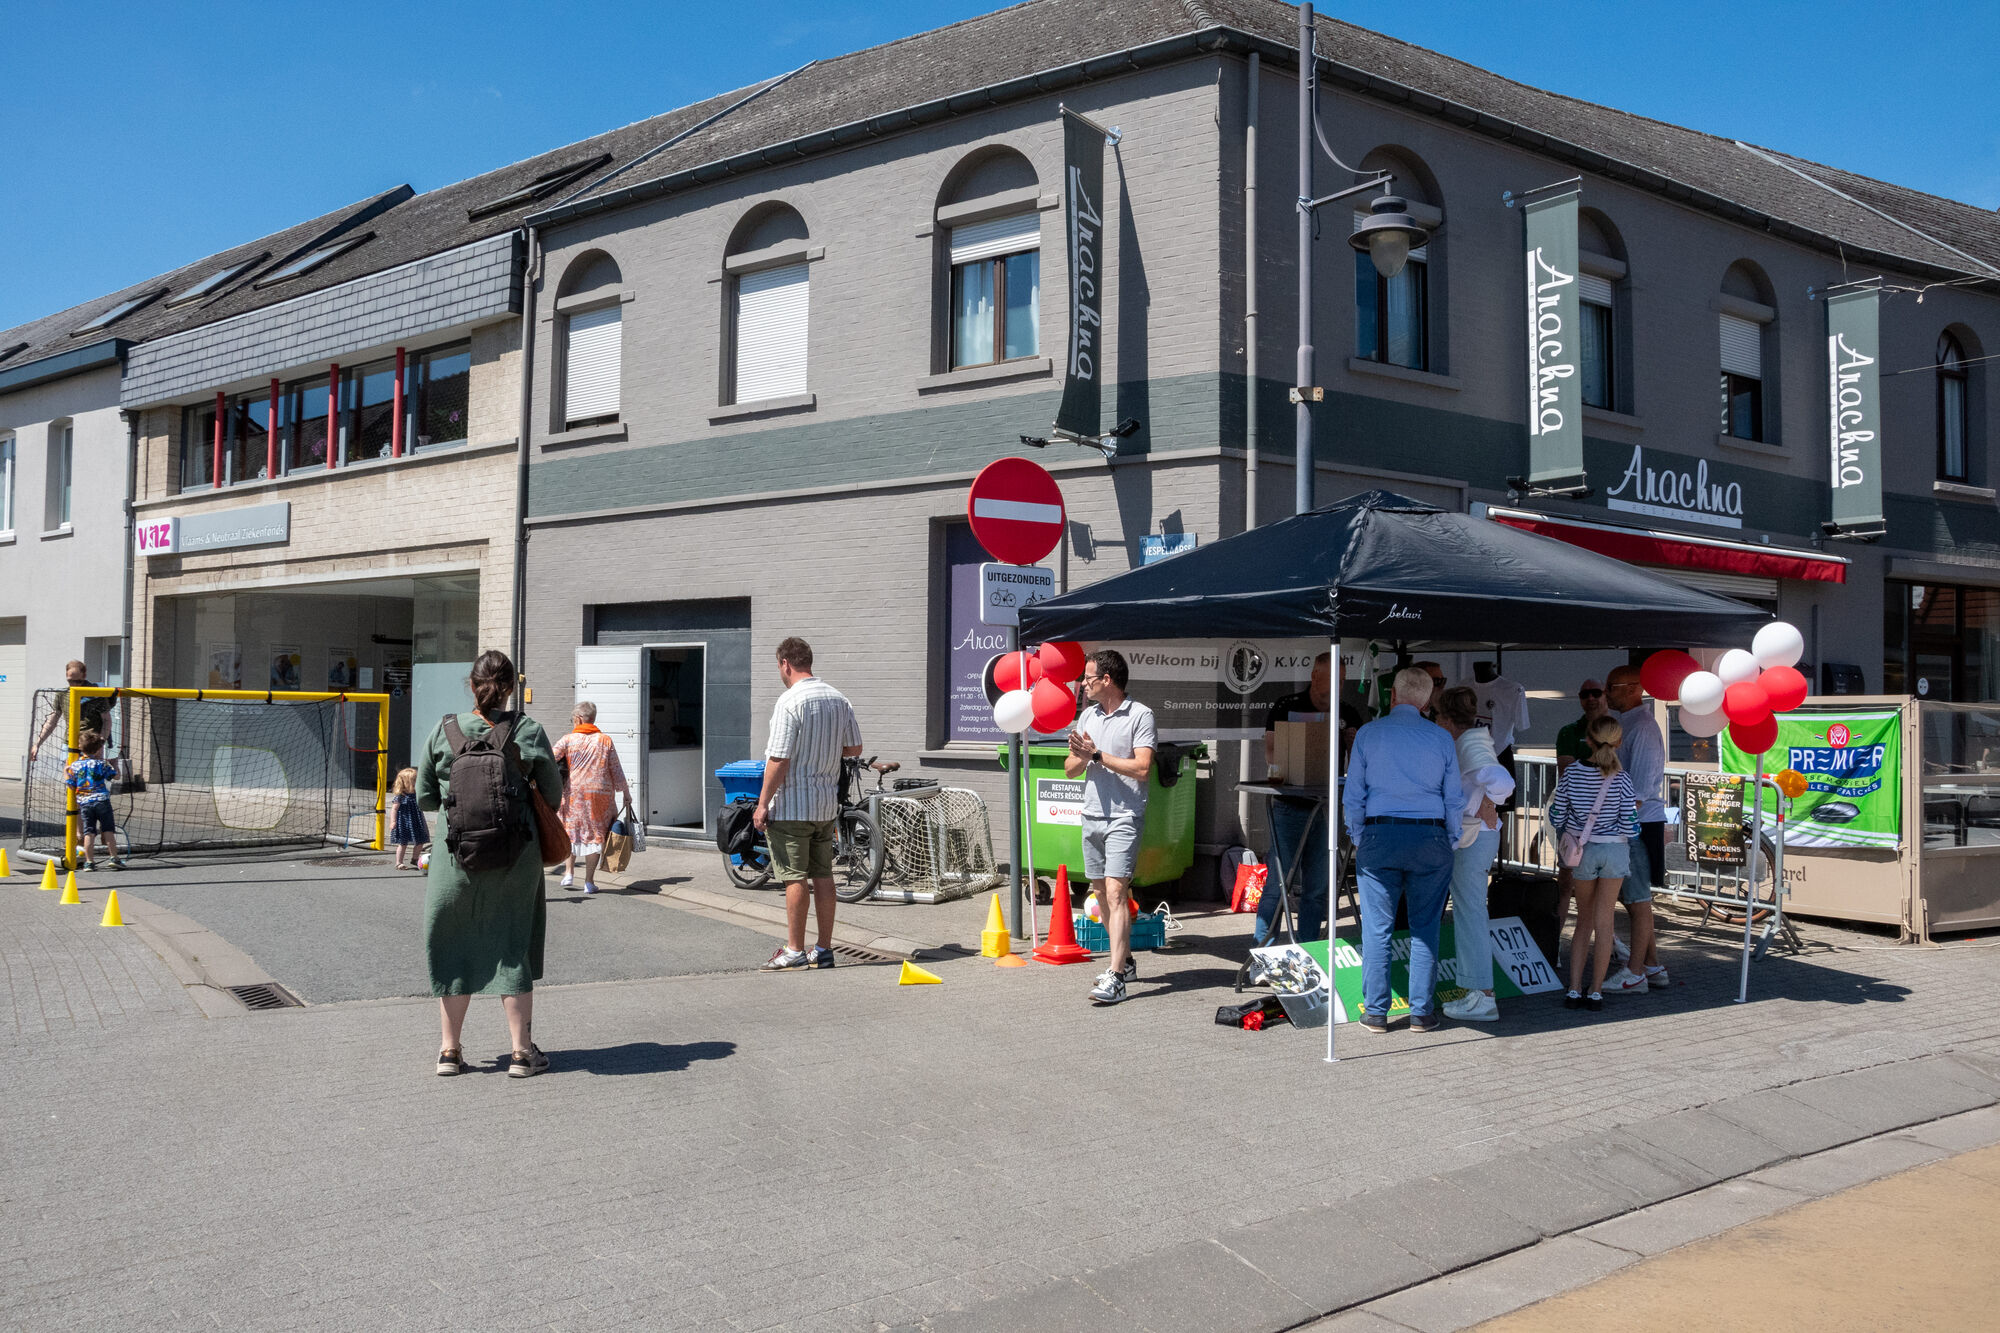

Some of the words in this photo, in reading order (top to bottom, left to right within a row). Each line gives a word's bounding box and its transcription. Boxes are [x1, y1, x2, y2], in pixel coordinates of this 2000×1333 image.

[1075, 168, 1102, 381] Arachna
[1529, 280, 1537, 403] RESTAURANT
[1536, 247, 1575, 437] Arachna
[1838, 332, 1875, 489] Arachna
[1607, 445, 1743, 514] Arachna
[182, 535, 204, 547] Vlaams
[212, 529, 241, 543] Neutraal
[241, 525, 285, 540] Ziekenfonds
[987, 571, 1051, 586] UITGEZONDERD
[1378, 603, 1422, 624] belavi
[953, 628, 1008, 650] Arac
[1129, 653, 1195, 667] Welkom
[1200, 655, 1219, 670] bij
[1163, 700, 1202, 710] Samen
[1205, 701, 1246, 711] bouwen
[1249, 702, 1267, 710] aan
[1789, 746, 1885, 770] PREMIER
[1051, 783, 1082, 792] RESTAFVAL
[1686, 773, 1729, 785] HOEKSKES
[1040, 790, 1064, 800] DÉCHETS
[1707, 799, 1741, 808] SPRINGER
[1711, 792, 1735, 800] GERRY
[1686, 791, 1697, 823] 19/07
[1706, 806, 1729, 814] SHOW
[1687, 827, 1698, 862] 20/07
[1708, 845, 1741, 853] JONGENS
[1489, 926, 1529, 951] 19/7
[1512, 951, 1529, 960] TOT
[1511, 961, 1551, 987] 22/7
